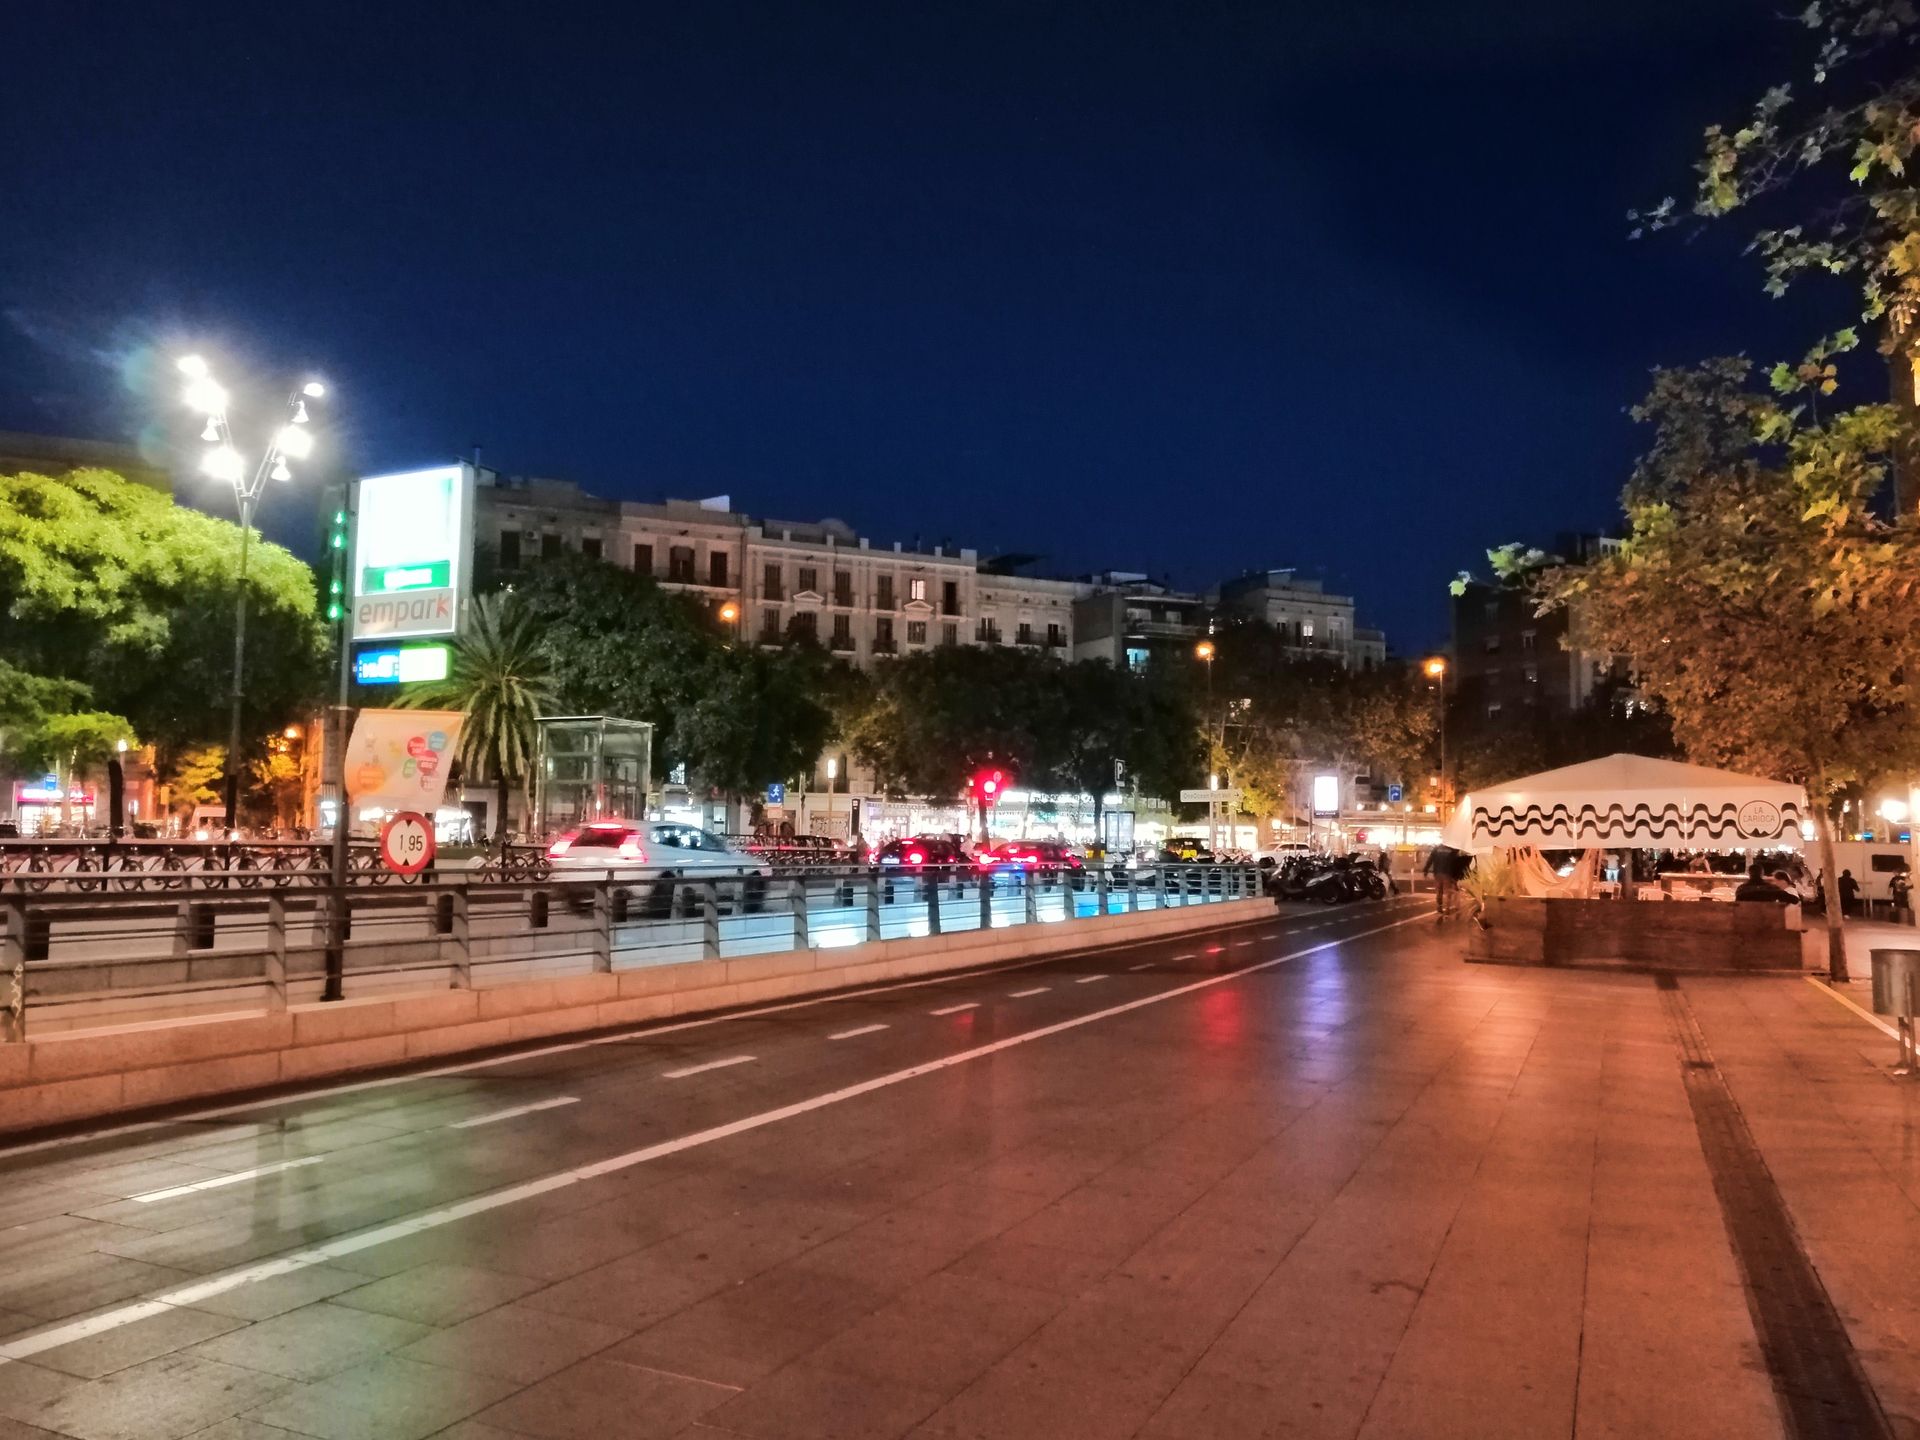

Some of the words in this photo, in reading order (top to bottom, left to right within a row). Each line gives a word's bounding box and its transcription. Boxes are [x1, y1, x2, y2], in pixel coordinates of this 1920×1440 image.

[359, 595, 449, 628] empark
[1117, 762, 1123, 780] P
[1754, 806, 1764, 814] LA
[1743, 814, 1775, 822] CARIOCA
